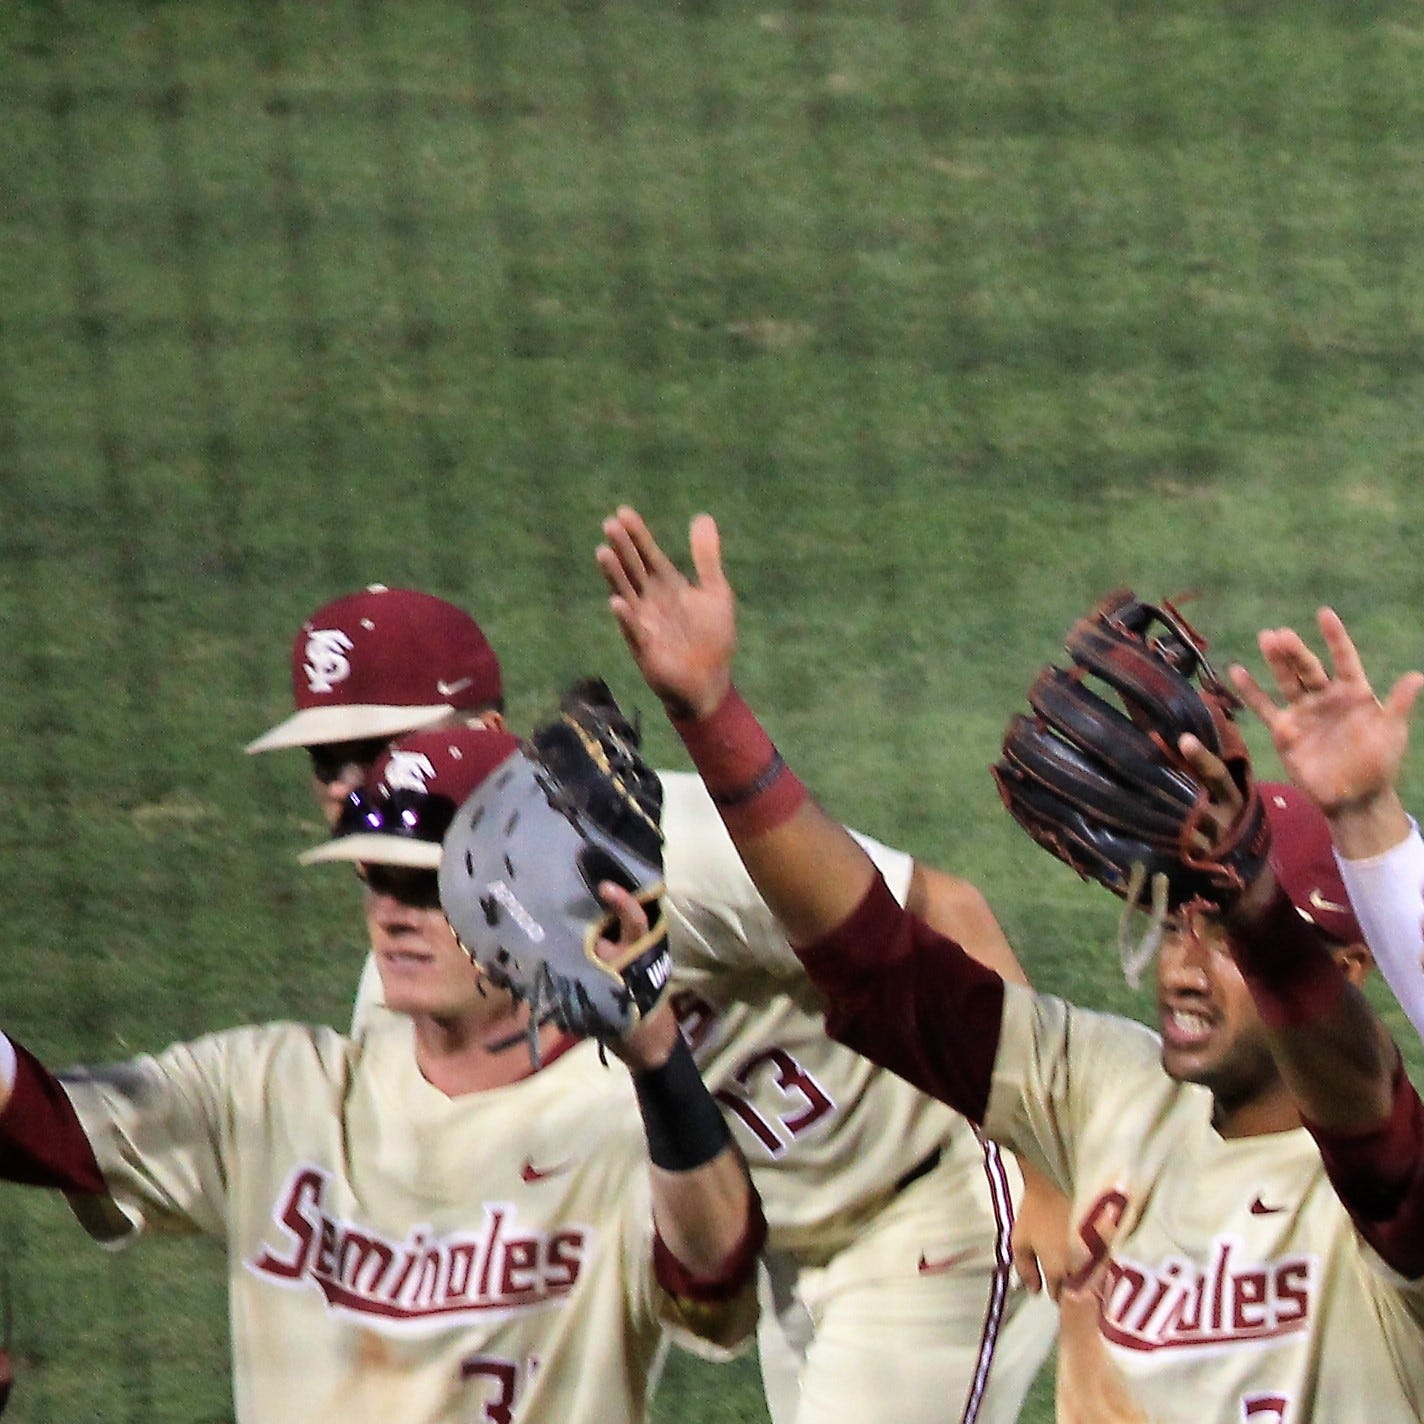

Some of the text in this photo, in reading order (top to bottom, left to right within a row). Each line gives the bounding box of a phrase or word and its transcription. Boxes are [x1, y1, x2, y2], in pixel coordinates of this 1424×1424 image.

[714, 1045, 838, 1160] 13
[244, 1160, 592, 1316] Seminoles
[1064, 1184, 1318, 1348] Smiles
